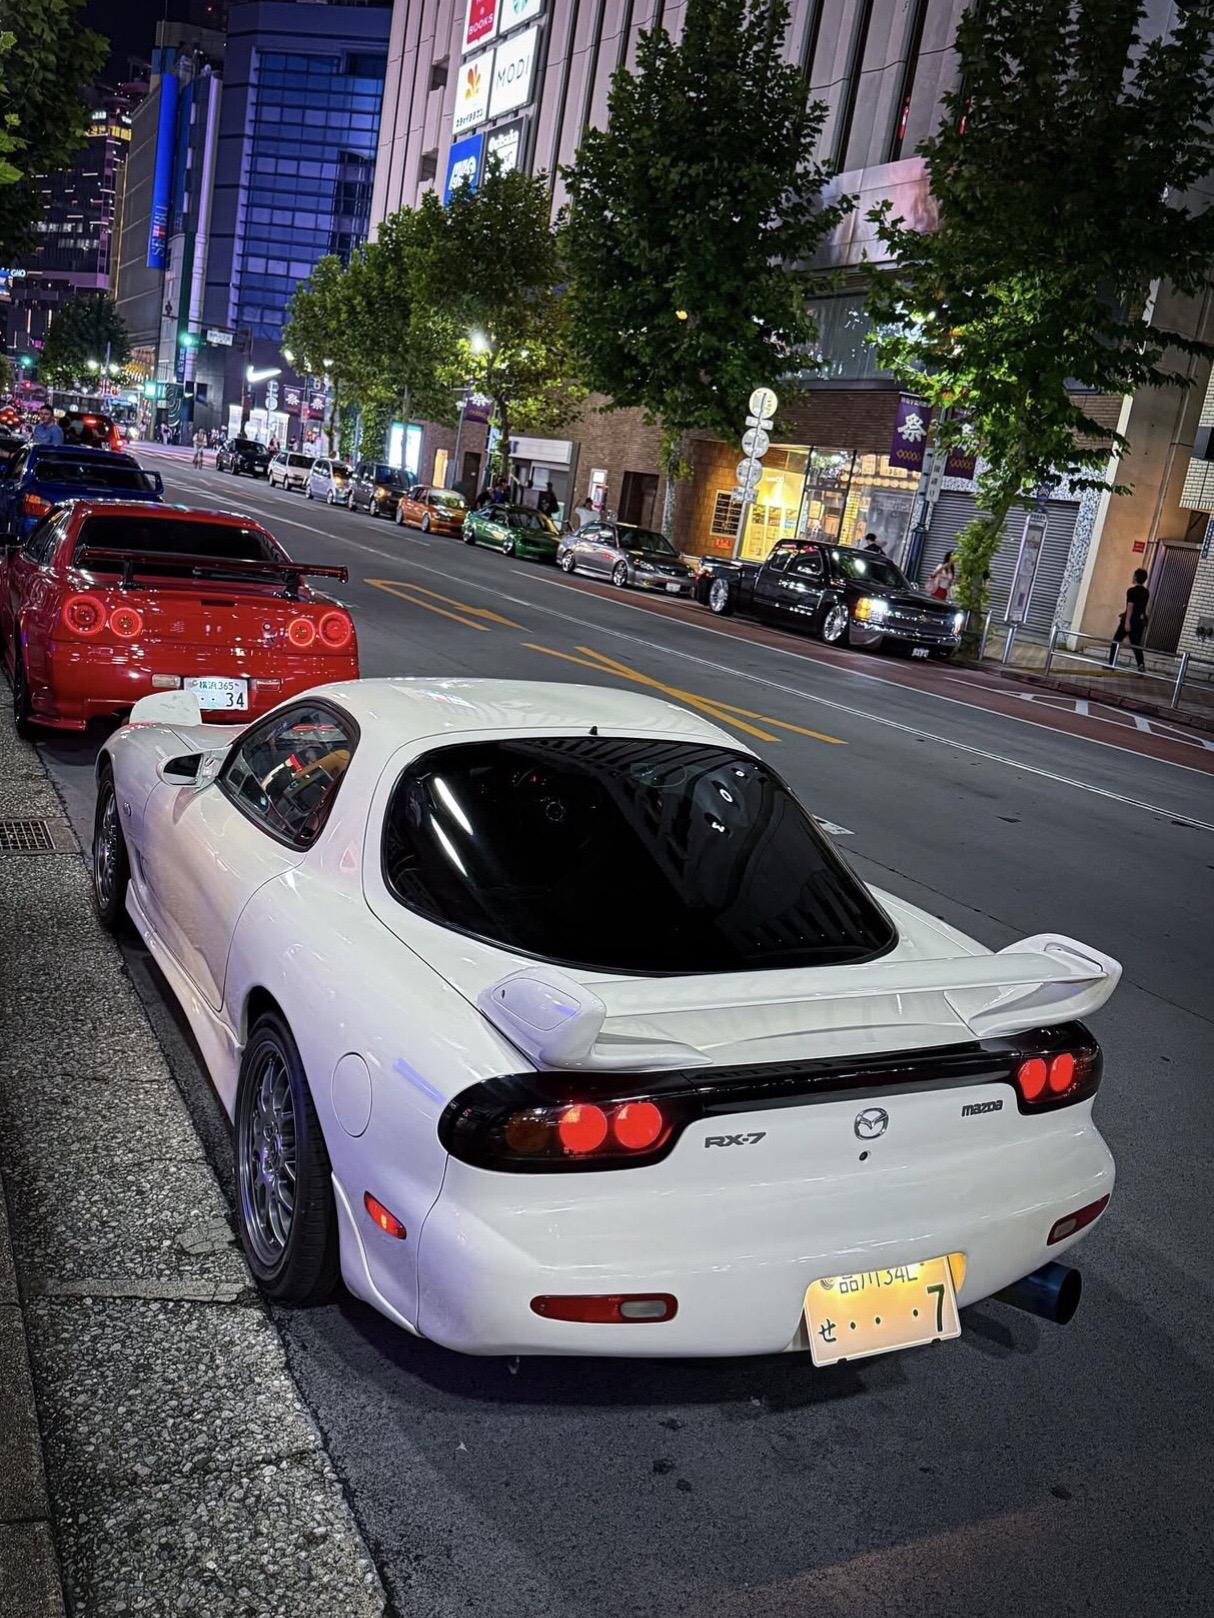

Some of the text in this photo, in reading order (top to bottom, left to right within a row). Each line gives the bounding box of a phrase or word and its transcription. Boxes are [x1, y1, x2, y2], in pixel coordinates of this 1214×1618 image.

[468, 13, 494, 36] BOOKS
[496, 55, 530, 90] MODI
[898, 413, 927, 442] 祭
[704, 1132, 767, 1149] RX-7
[818, 1318, 837, 1343] せ
